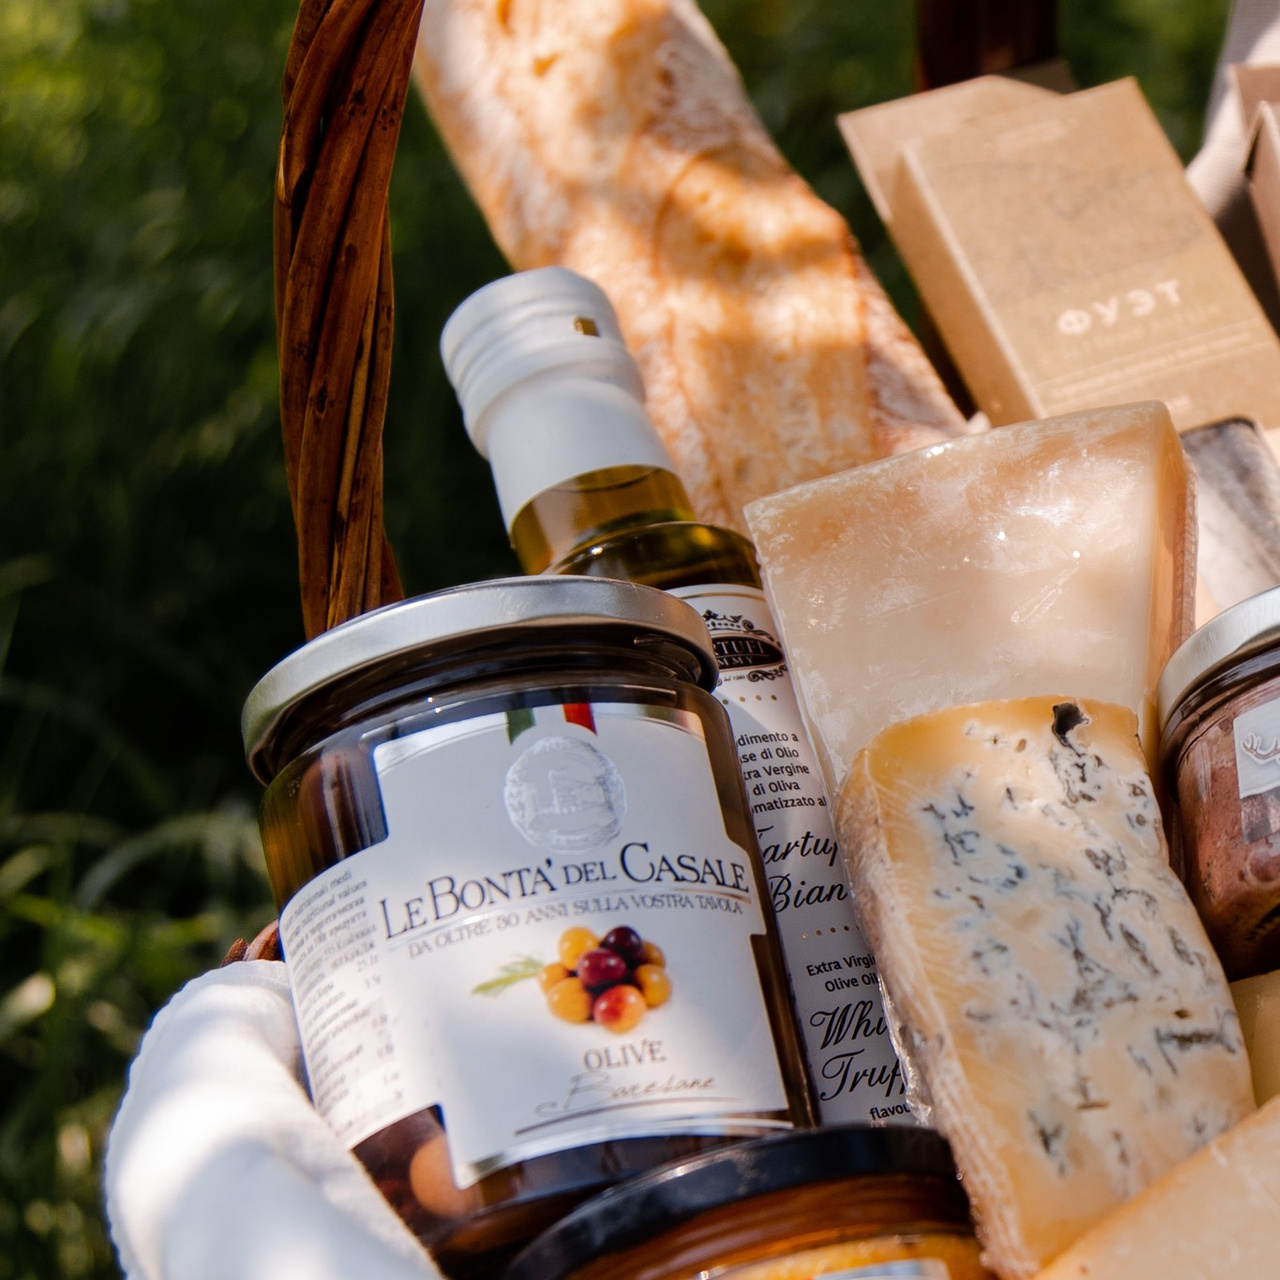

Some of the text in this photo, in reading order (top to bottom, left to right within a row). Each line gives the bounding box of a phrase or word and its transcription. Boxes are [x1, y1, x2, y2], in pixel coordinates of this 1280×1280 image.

[1057, 278, 1182, 336] ФУЭТ
[737, 732, 799, 747] dimento a
[760, 748, 773, 760] di
[775, 747, 799, 758] Olio
[743, 763, 810, 780] tra Vergine
[752, 780, 801, 796] di Oliva
[752, 796, 816, 813] matizzato
[562, 860, 617, 886] DEL
[619, 842, 750, 894] CASALE
[768, 873, 848, 913] Bian
[408, 939, 432, 958] DA
[434, 919, 493, 947] OLTRE
[525, 901, 569, 925] ANNI
[573, 894, 630, 915] SULLA
[630, 893, 695, 910] VOSTRA
[695, 894, 744, 915] TAVOLA
[806, 960, 843, 977] Extra
[825, 972, 879, 992] Olive Oil
[809, 1000, 888, 1050] Whi
[583, 1037, 667, 1072] OLIVE
[820, 1048, 906, 1101] Truf
